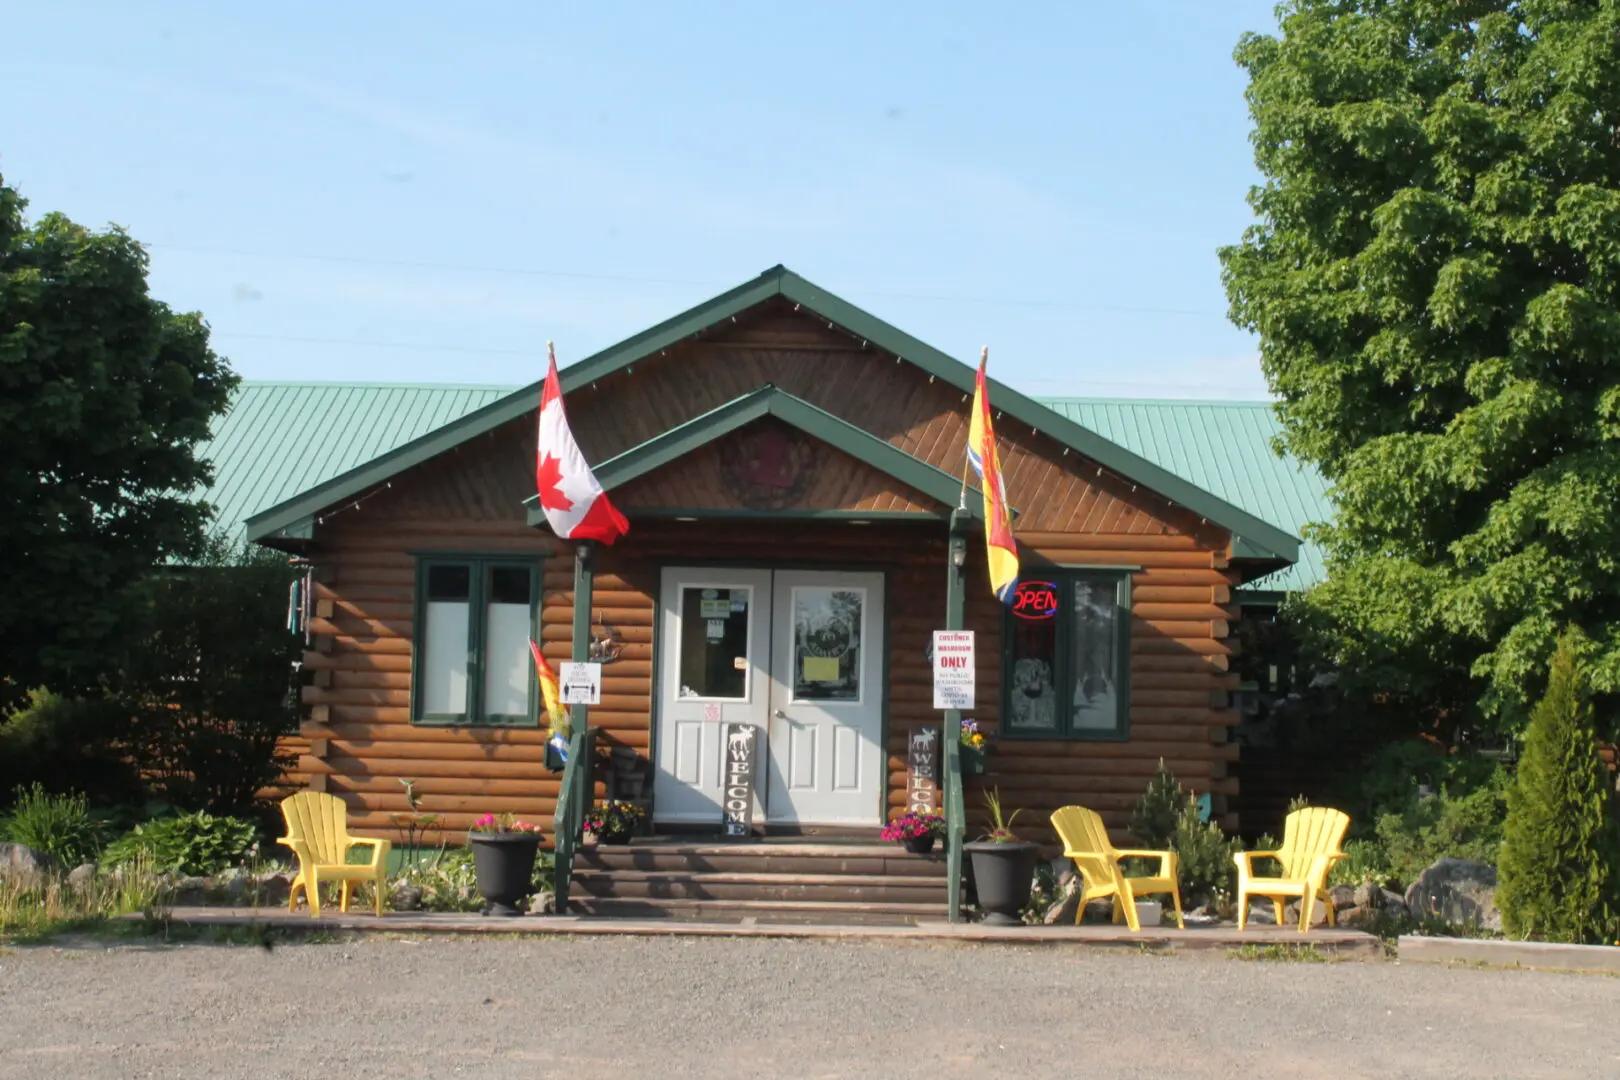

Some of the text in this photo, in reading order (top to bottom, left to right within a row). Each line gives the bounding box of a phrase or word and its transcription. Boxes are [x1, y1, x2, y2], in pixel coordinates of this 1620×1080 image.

[1013, 590, 1058, 610] OPEN
[940, 656, 967, 669] ONLY
[727, 750, 750, 836] WELCOME
[911, 752, 933, 813] WELCO
